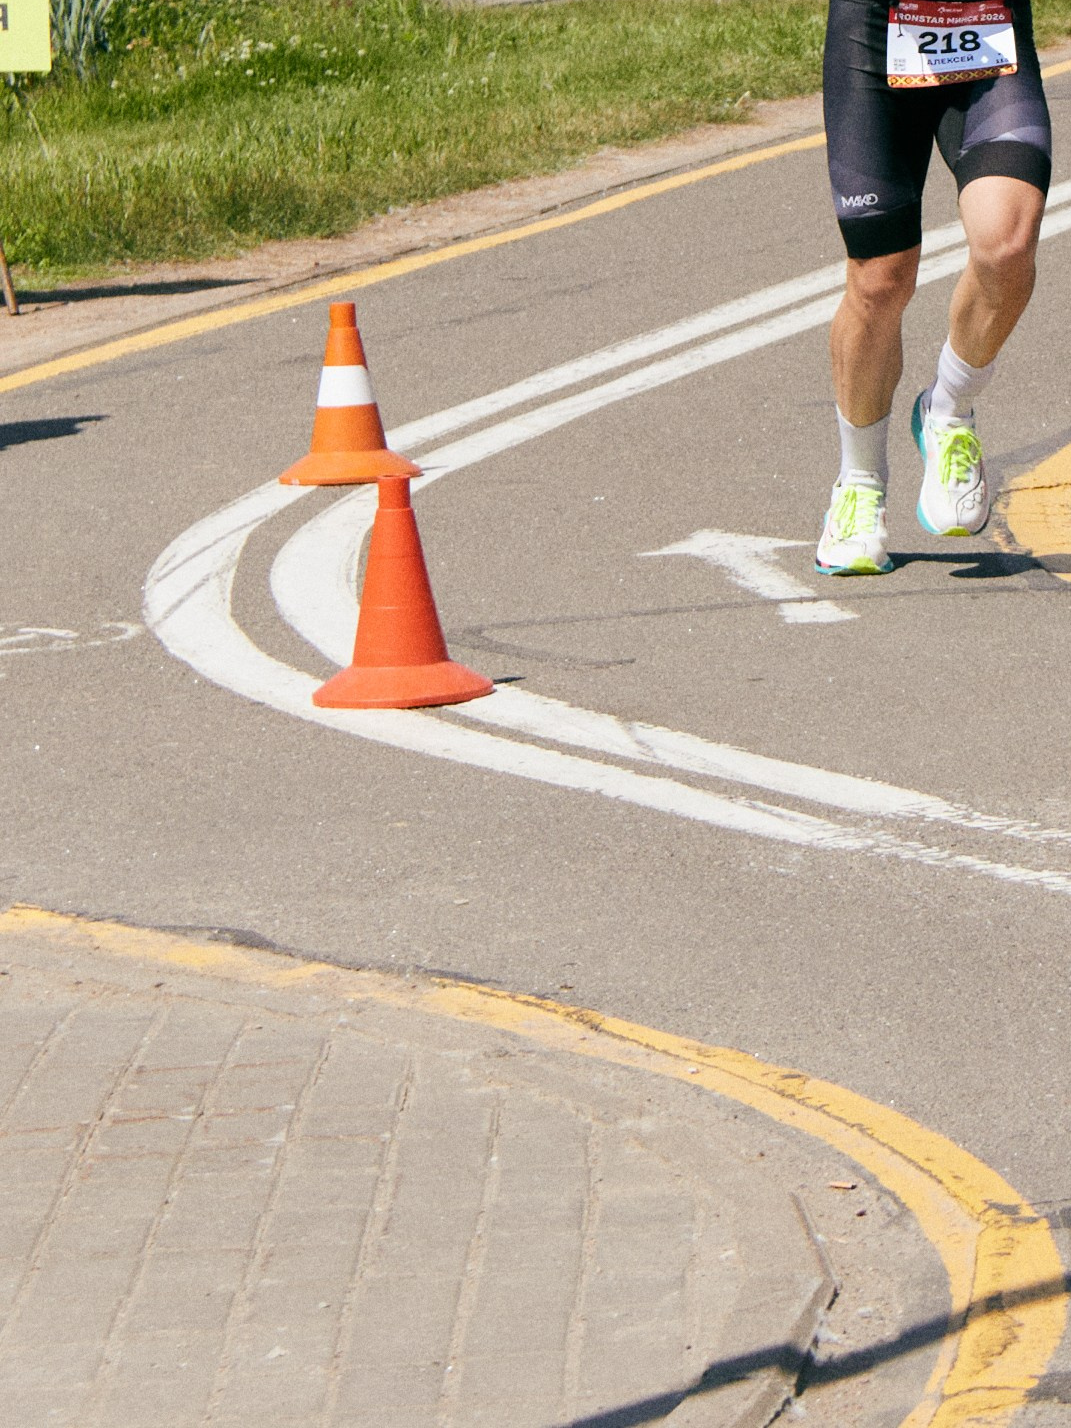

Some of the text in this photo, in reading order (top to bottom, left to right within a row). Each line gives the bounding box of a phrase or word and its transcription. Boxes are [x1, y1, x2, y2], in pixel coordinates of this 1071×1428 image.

[894, 12, 944, 24] IRONSTAR
[980, 13, 1006, 22] 2026
[918, 30, 981, 55] 218
[927, 54, 974, 66] АЛЕКСЕЙ
